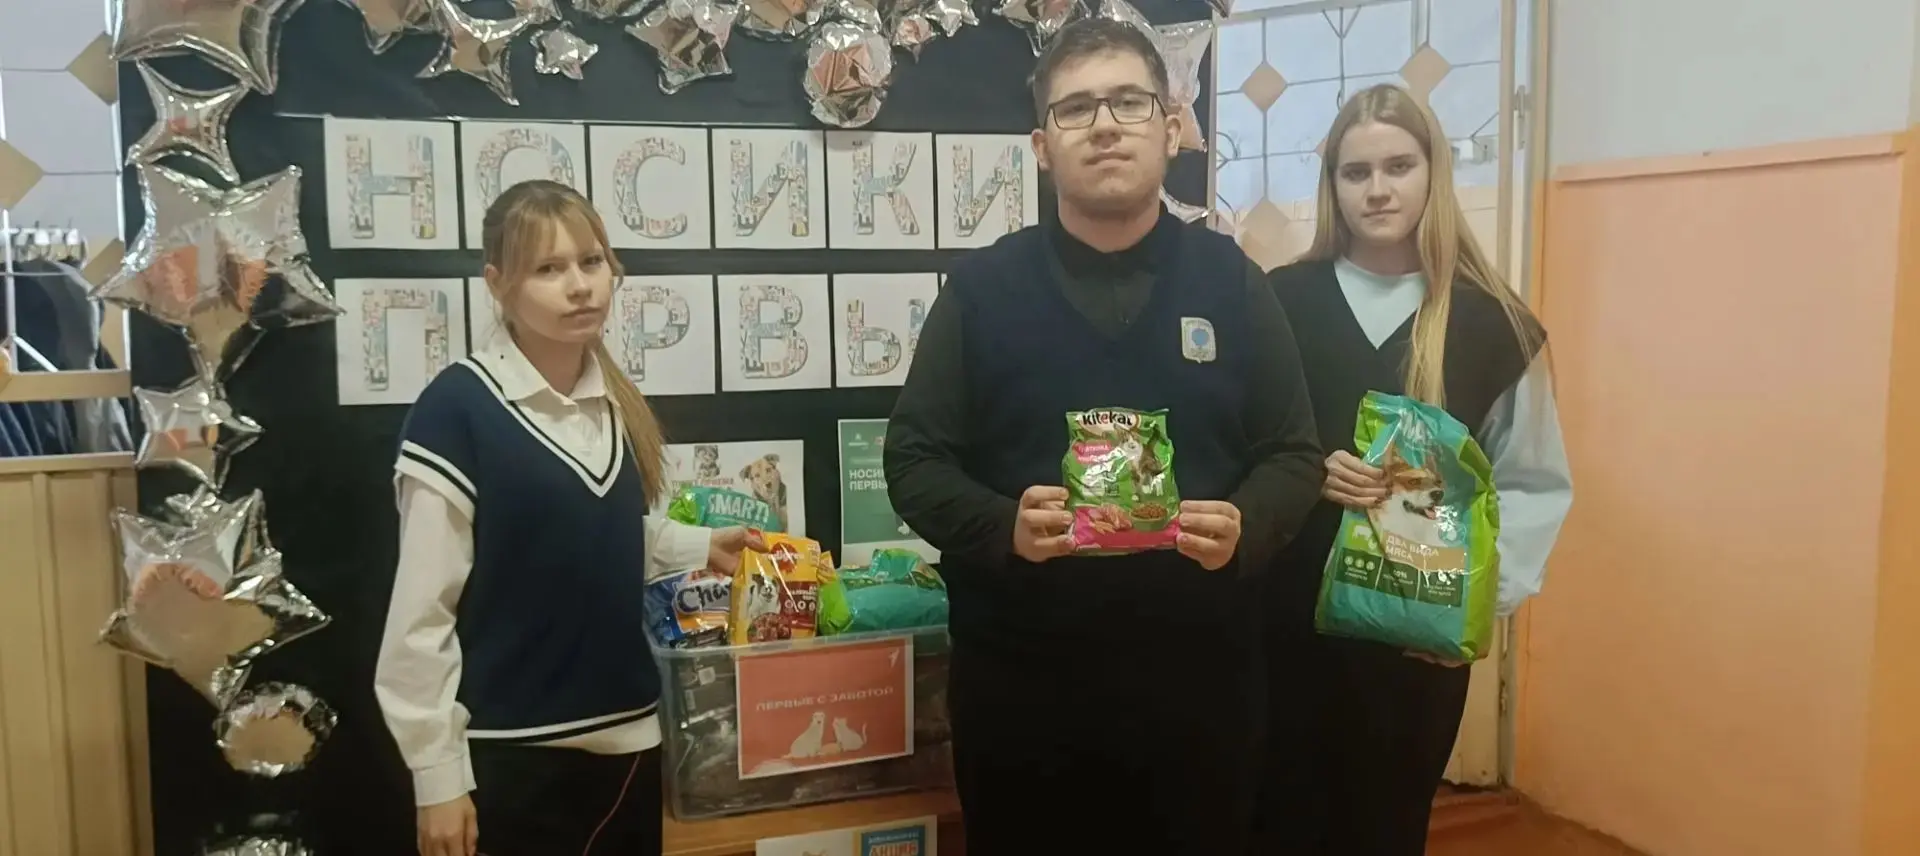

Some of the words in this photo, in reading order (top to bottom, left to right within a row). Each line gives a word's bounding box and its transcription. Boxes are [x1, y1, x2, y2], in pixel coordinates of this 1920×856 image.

[361, 284, 926, 391] ПРВЫ
[755, 696, 814, 712] ПЕРВЫЕ
[817, 695, 826, 705] С
